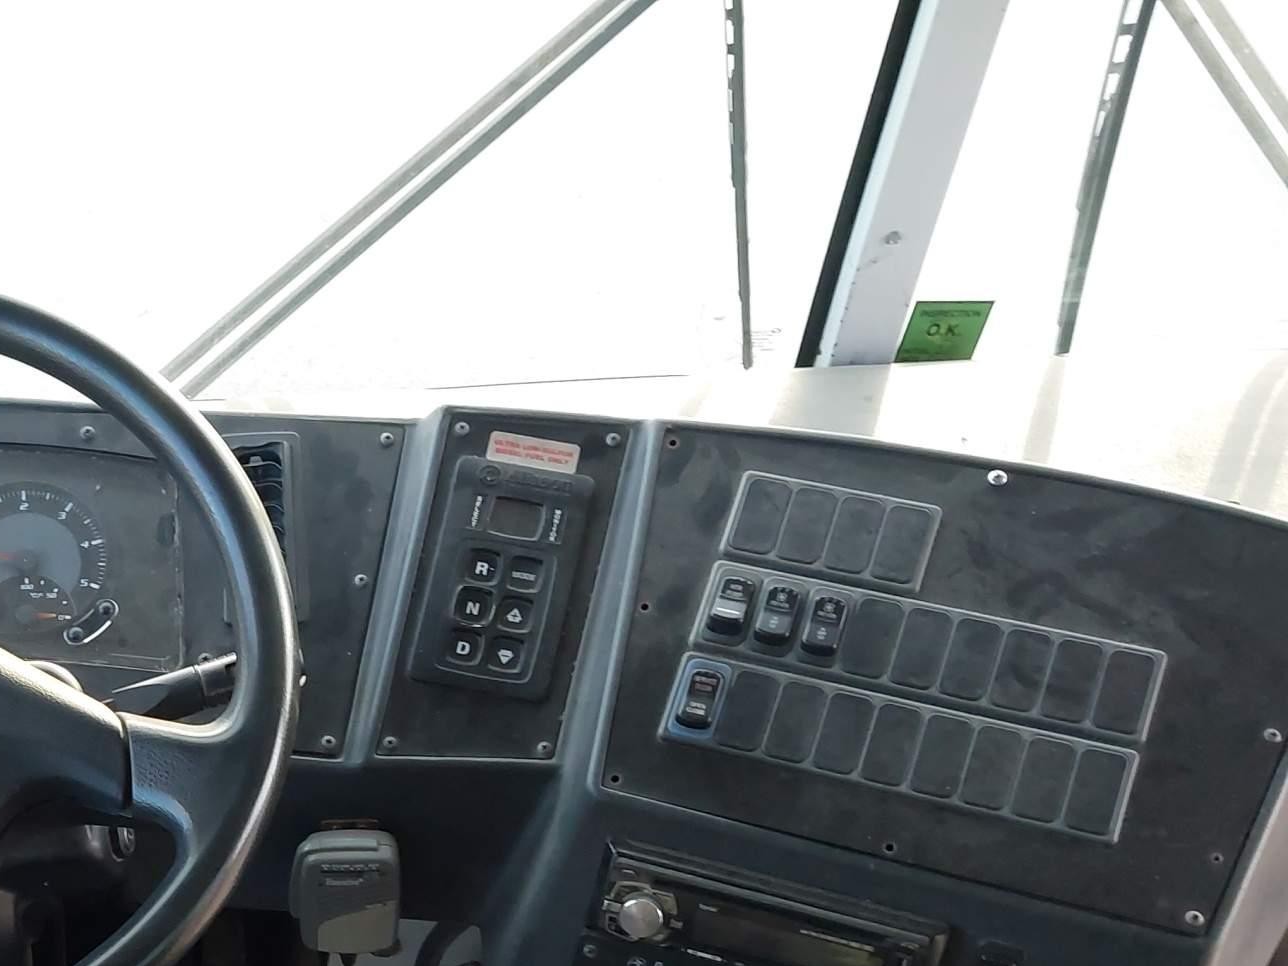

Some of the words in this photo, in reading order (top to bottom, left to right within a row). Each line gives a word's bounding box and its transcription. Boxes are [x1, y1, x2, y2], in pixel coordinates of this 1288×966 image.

[19, 502, 30, 511] 2
[57, 512, 67, 520] 3
[79, 540, 89, 548] 4
[474, 561, 489, 576] R
[79, 578, 89, 587] 5
[466, 601, 480, 616] N
[455, 641, 470, 656] D
